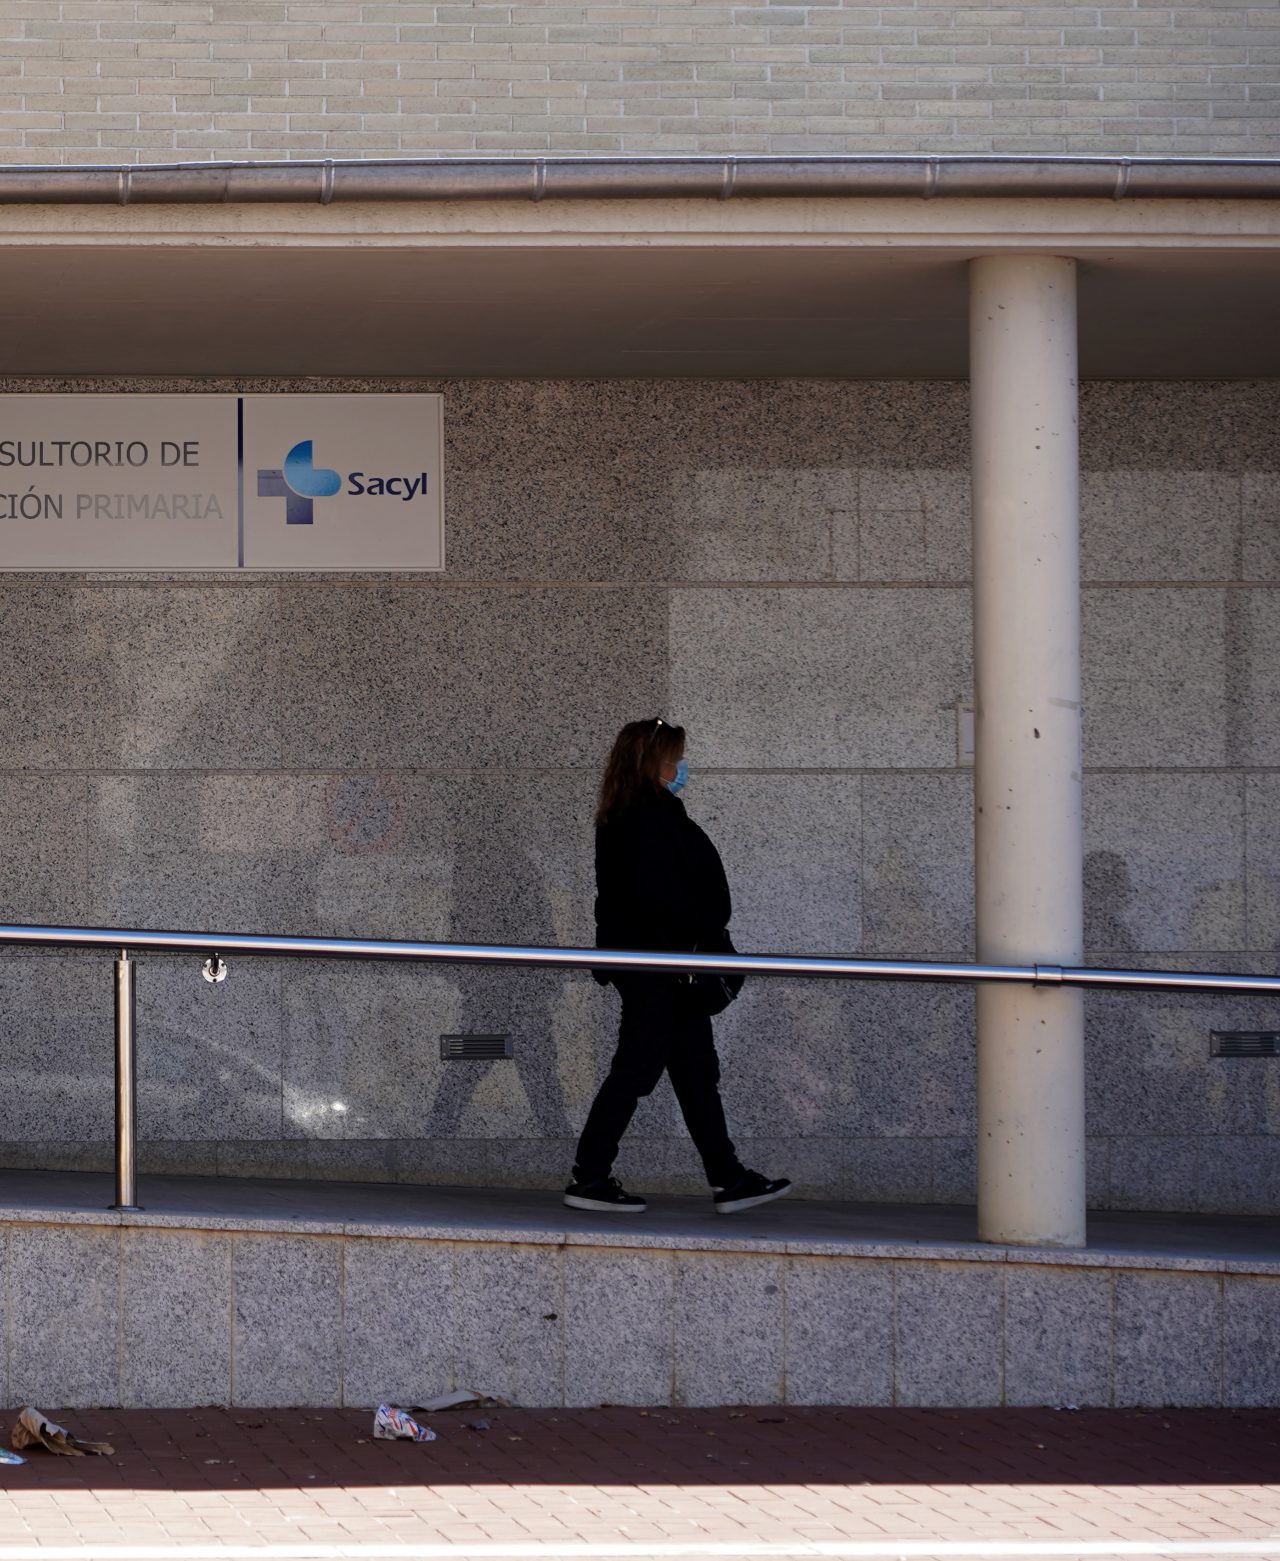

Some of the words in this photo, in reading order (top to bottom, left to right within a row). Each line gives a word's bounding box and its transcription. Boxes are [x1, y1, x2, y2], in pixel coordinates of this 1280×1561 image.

[160, 441, 200, 467] DE
[347, 471, 428, 501] Sacyl
[75, 493, 224, 520] PRIMARIA
